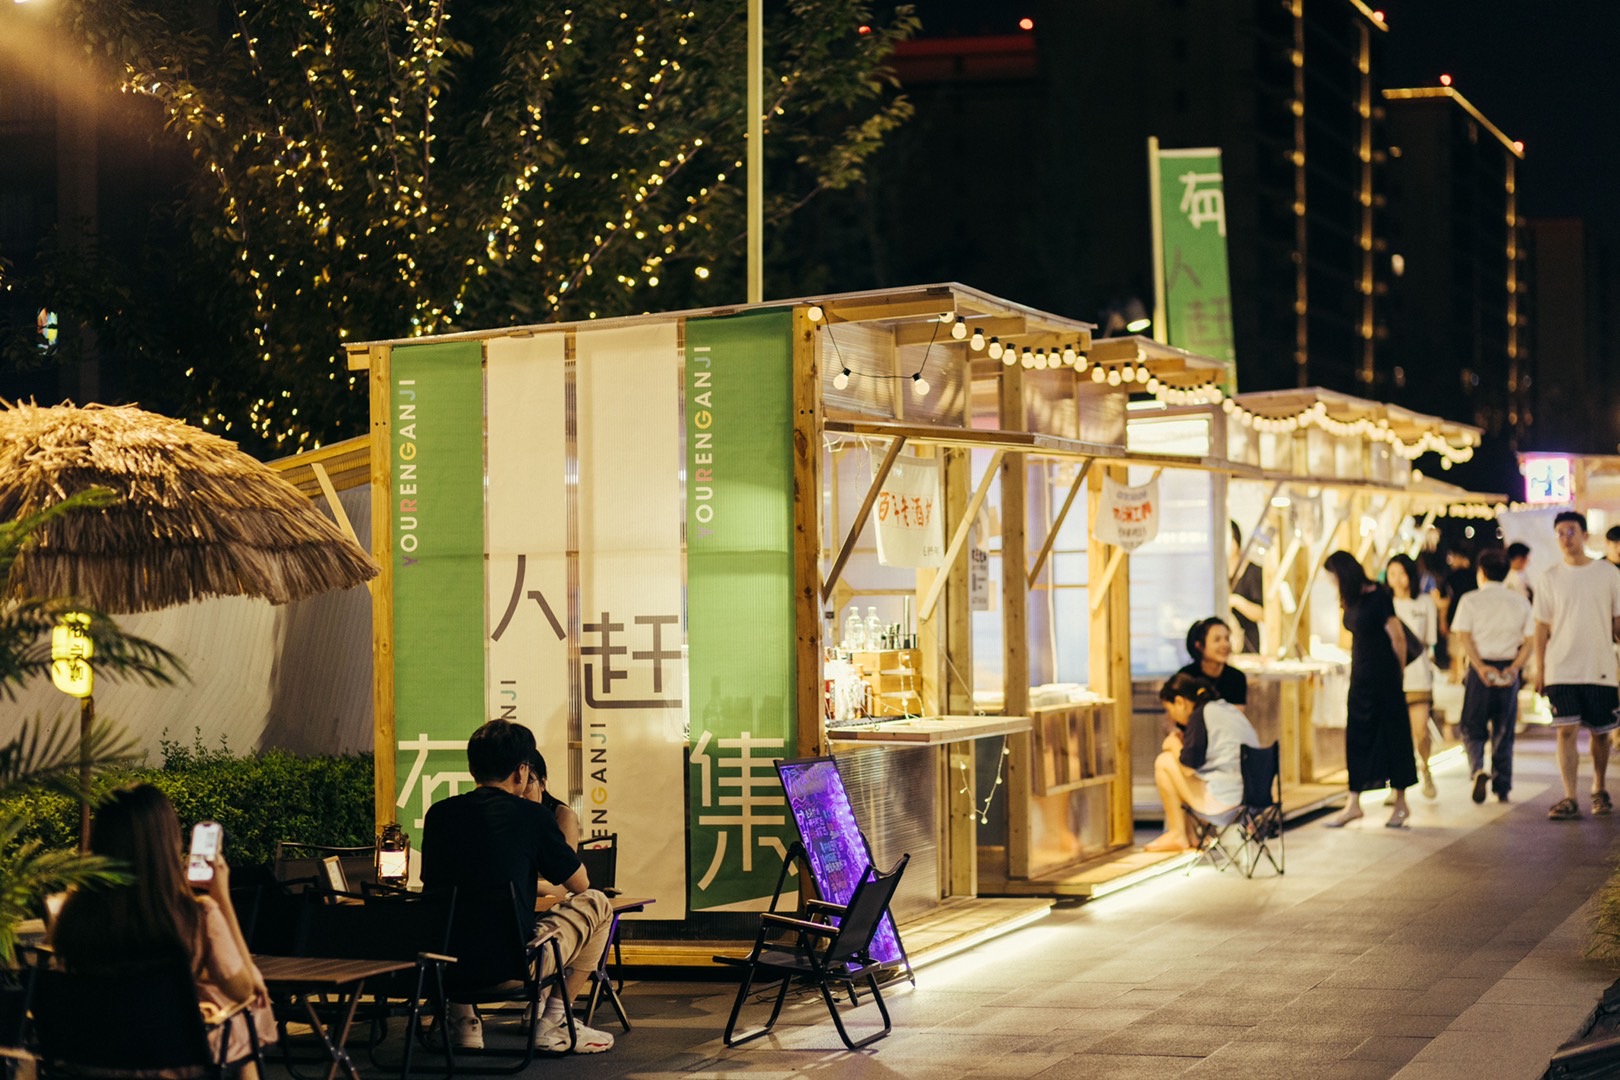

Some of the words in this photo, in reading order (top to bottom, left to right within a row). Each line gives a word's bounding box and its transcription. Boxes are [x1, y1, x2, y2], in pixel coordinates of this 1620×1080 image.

[398, 380, 419, 567] YOURENGANJI
[694, 346, 715, 539] YOURENGANJI
[490, 554, 567, 642] 人
[581, 611, 683, 710] 赶
[689, 730, 800, 891] 集
